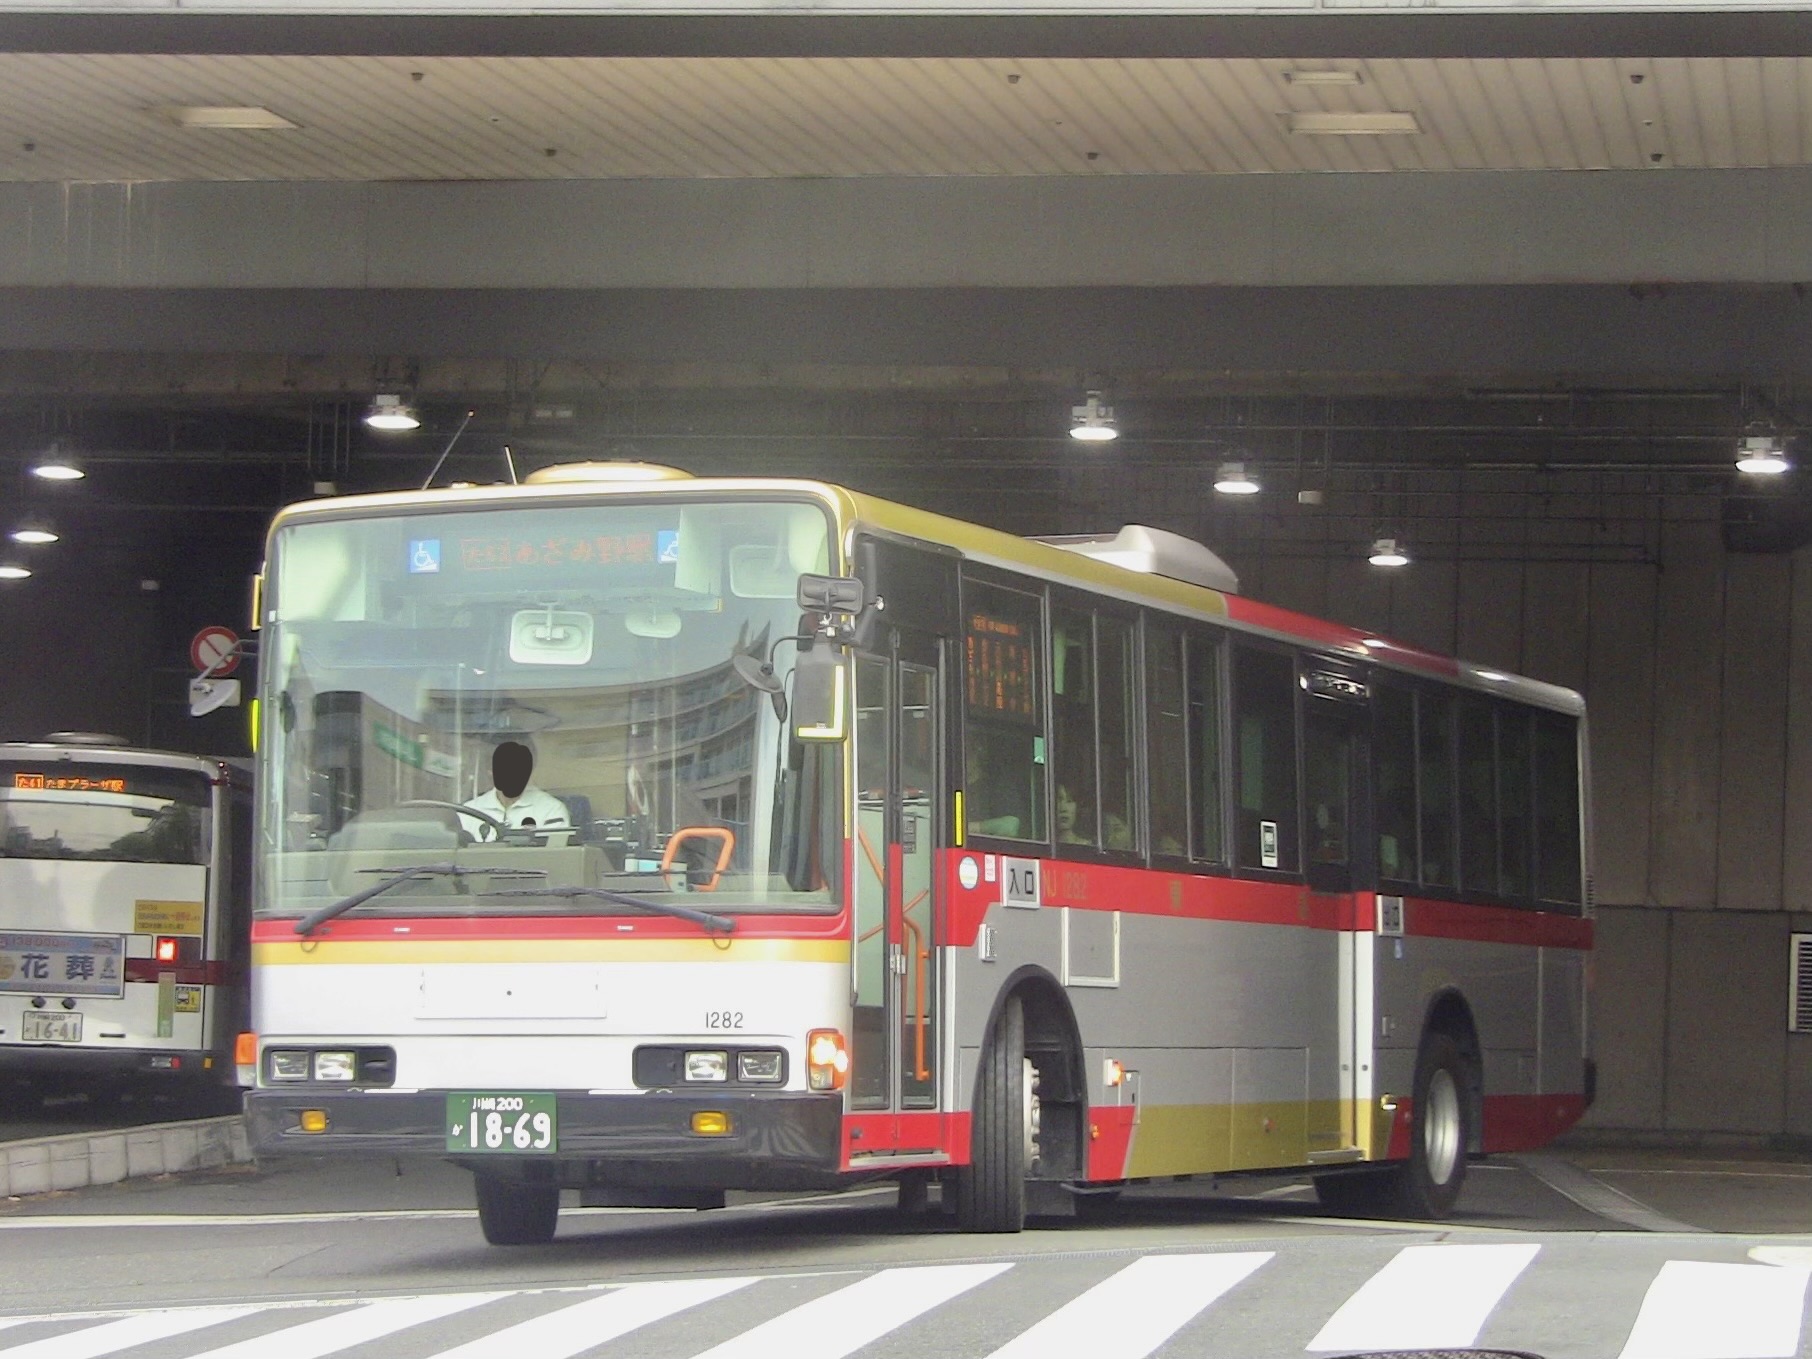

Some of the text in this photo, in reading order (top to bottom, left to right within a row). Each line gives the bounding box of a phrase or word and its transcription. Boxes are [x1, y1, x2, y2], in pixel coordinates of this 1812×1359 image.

[46, 778, 124, 792] たまプラーザ駅
[1009, 868, 1034, 895] 入口
[705, 1011, 744, 1029] 1282
[496, 1097, 524, 1111] 200
[470, 1111, 551, 1149] 18-69
